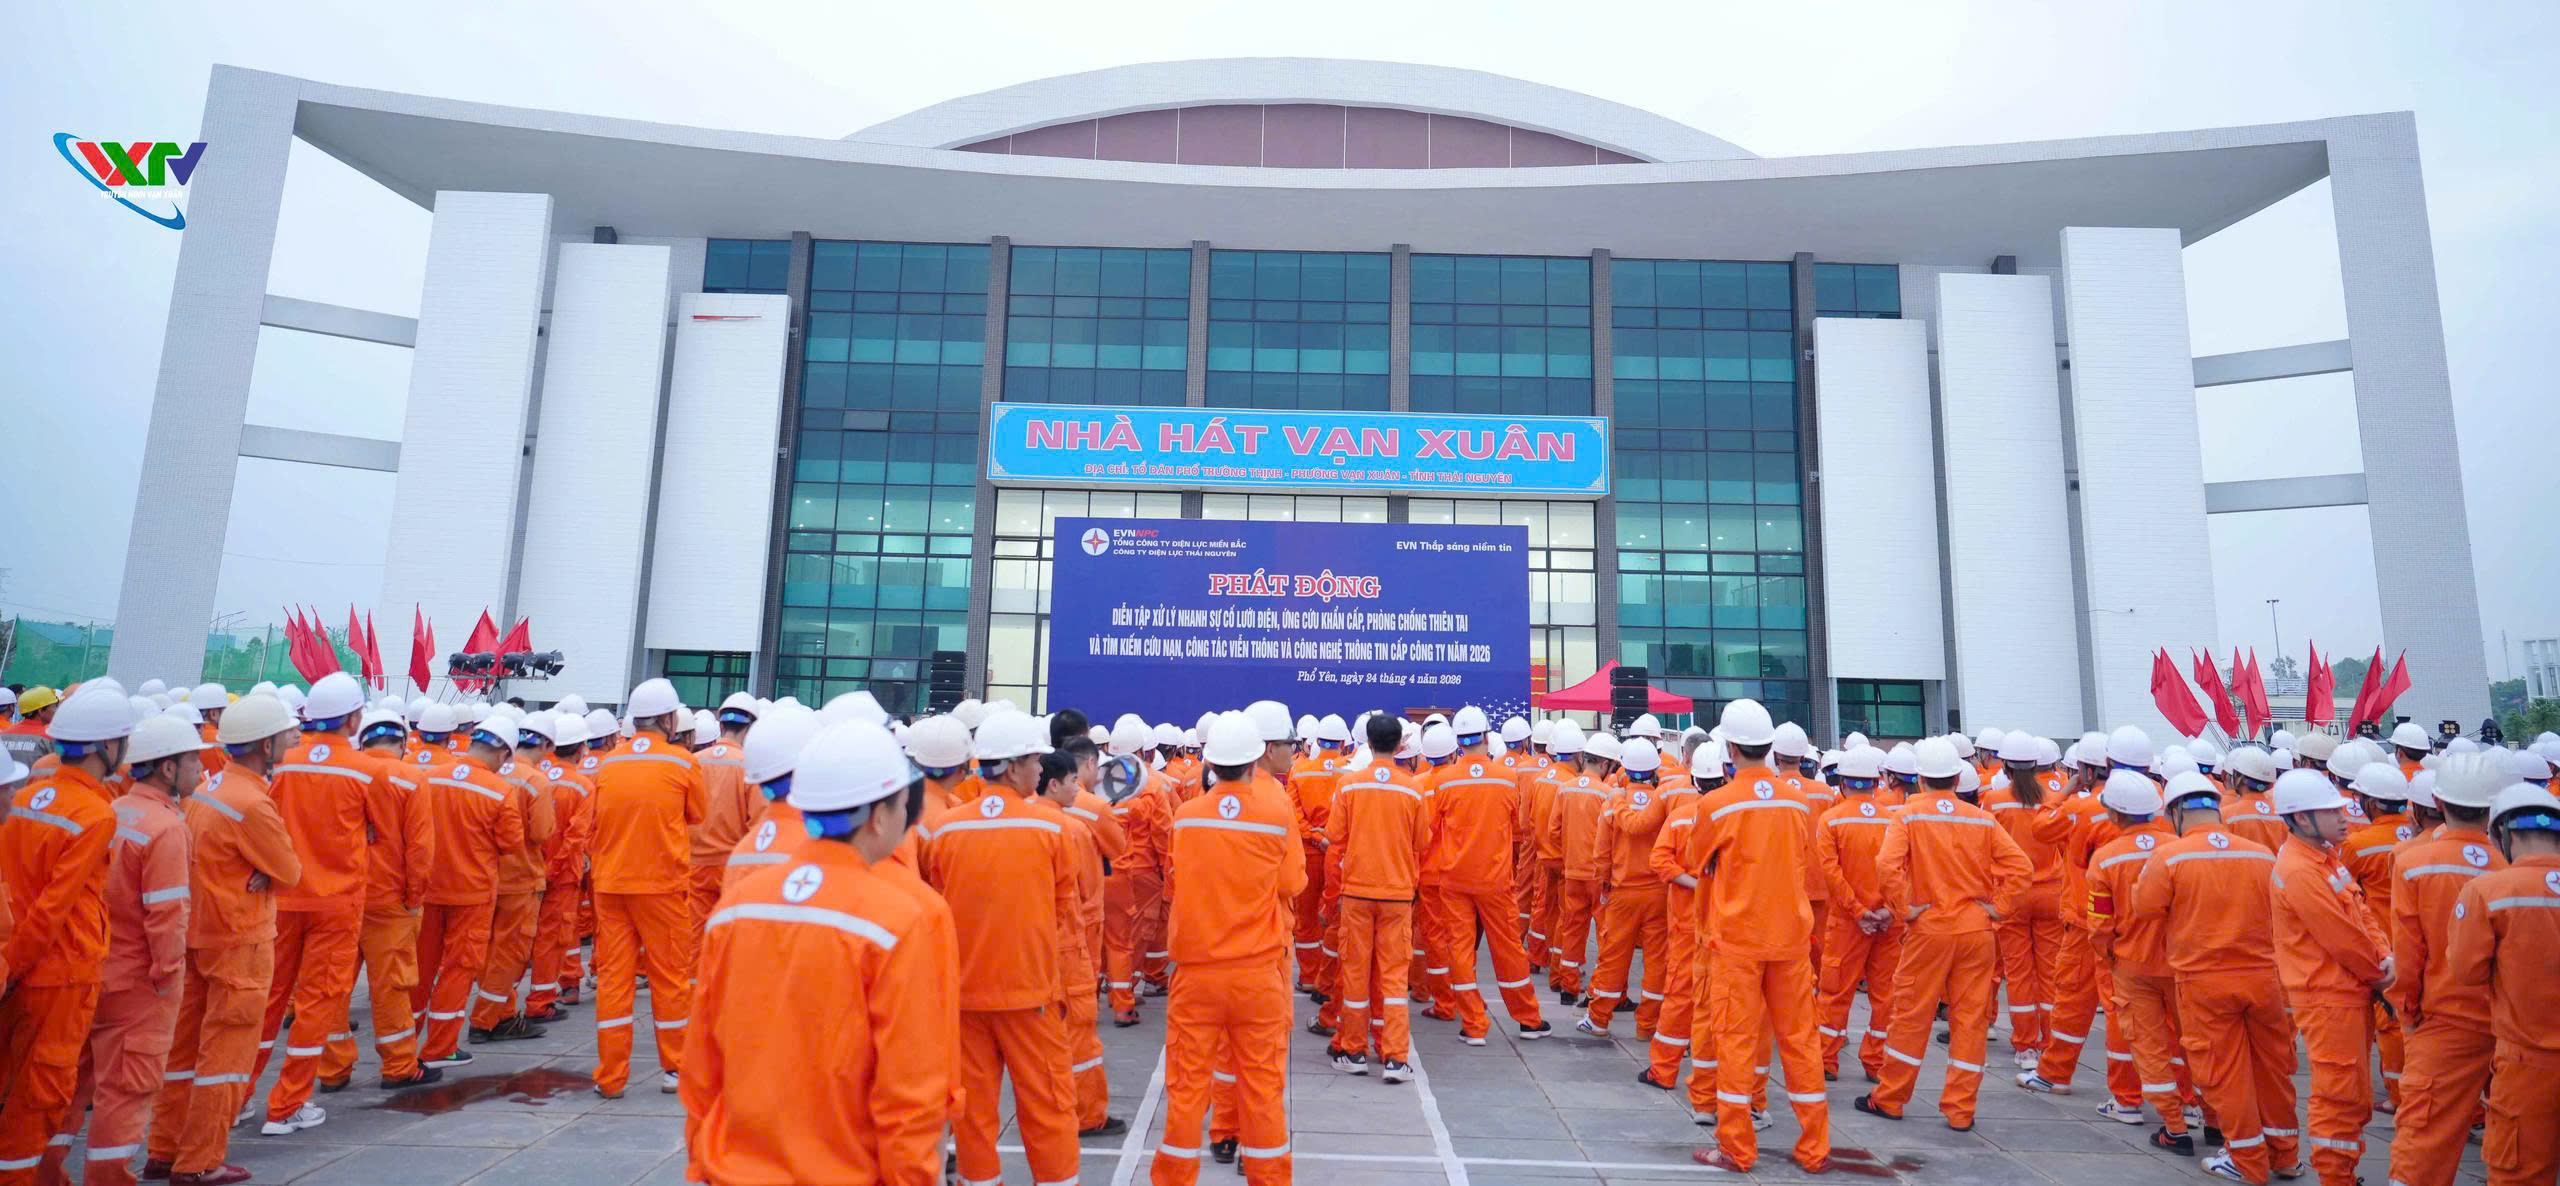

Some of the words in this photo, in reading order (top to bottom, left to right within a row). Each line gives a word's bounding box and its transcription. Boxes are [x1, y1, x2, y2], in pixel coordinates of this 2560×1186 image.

[1026, 415, 1142, 451] NHÀ
[1159, 417, 1268, 454] HÁT
[1283, 427, 1399, 465] VẠN
[1415, 424, 1575, 461] XUÂN
[1084, 463, 1104, 476] ĐỊA
[1149, 464, 1173, 476] DÂN
[1176, 462, 1199, 476] PHỐ
[1202, 465, 1246, 478] TRƯỜNG
[1249, 467, 1282, 480] THỊNH
[1291, 467, 1338, 479] PHƯỜNG
[1341, 469, 1364, 482] VẠN
[1368, 469, 1400, 480] XUÂN
[1410, 468, 1435, 481] TỈNH
[1437, 471, 1463, 482] THÁI
[1465, 472, 1513, 484] NGUYÊN
[1113, 537, 1135, 546] TỔNG
[1136, 539, 1158, 547] CÔNG
[1172, 539, 1190, 549] ĐIỆN
[1192, 540, 1208, 549] LỰC
[1230, 538, 1247, 548] BẮC
[1148, 549, 1166, 557] ĐIỆN
[1185, 549, 1203, 557] THÁI
[1204, 549, 1237, 557] NGUYÊN
[1396, 541, 1417, 550] EVN
[1420, 540, 1444, 552] Thắp
[1446, 542, 1470, 553] sáng
[1499, 543, 1512, 552] tin
[1208, 567, 1289, 597] PHÁT
[1294, 568, 1381, 602] ĐỘNG
[1112, 602, 1132, 626] DIỄN
[1134, 605, 1150, 630] TẬP
[1152, 603, 1165, 627] XỬ
[1166, 606, 1176, 627] LÝ
[1178, 609, 1207, 628] NHANH
[1210, 608, 1222, 631] SỰ
[1223, 604, 1235, 628] CỐ
[1237, 607, 1256, 628] LƯỚI
[1257, 608, 1280, 631] ĐIỆN,
[1282, 607, 1299, 629] ỨNG
[1302, 608, 1318, 630] CỨU
[1321, 606, 1345, 630] KHẨN
[1347, 607, 1365, 632] CẤP,
[1367, 609, 1395, 631] PHÒNG
[1399, 608, 1427, 631] CHỐNG
[1429, 611, 1453, 632] THIÊN
[1456, 614, 1468, 632] TAI
[1089, 634, 1100, 655] VÀ
[1103, 634, 1118, 655] TÌM
[1120, 633, 1141, 656] KIẾM
[1144, 634, 1161, 656] CỨU
[1163, 639, 1184, 660] NẠN,
[1186, 636, 1209, 657] CÔNG
[1211, 636, 1228, 658] TÁC
[1229, 634, 1249, 658] VIỄN
[1251, 637, 1278, 658] THÔNG
[1281, 638, 1292, 659] VÀ
[1294, 639, 1317, 660] CÔNG
[1320, 638, 1342, 663] NGHỆ
[1344, 639, 1373, 660] THÔNG
[1374, 643, 1389, 660] TIN
[1390, 637, 1408, 661] CẤP
[1410, 640, 1433, 661] CÔNG
[1435, 644, 1446, 661] TY
[1447, 641, 1468, 662] NĂM
[1469, 645, 1491, 663] 2026
[1297, 667, 1317, 681] Phổ
[1318, 671, 1338, 684] Yên,
[1340, 673, 1364, 685] ngày
[1366, 672, 1377, 683] 24
[1380, 672, 1407, 686] tháng
[1409, 673, 1416, 684] 4
[1417, 673, 1437, 684] năm
[1439, 674, 1462, 685] 2026
